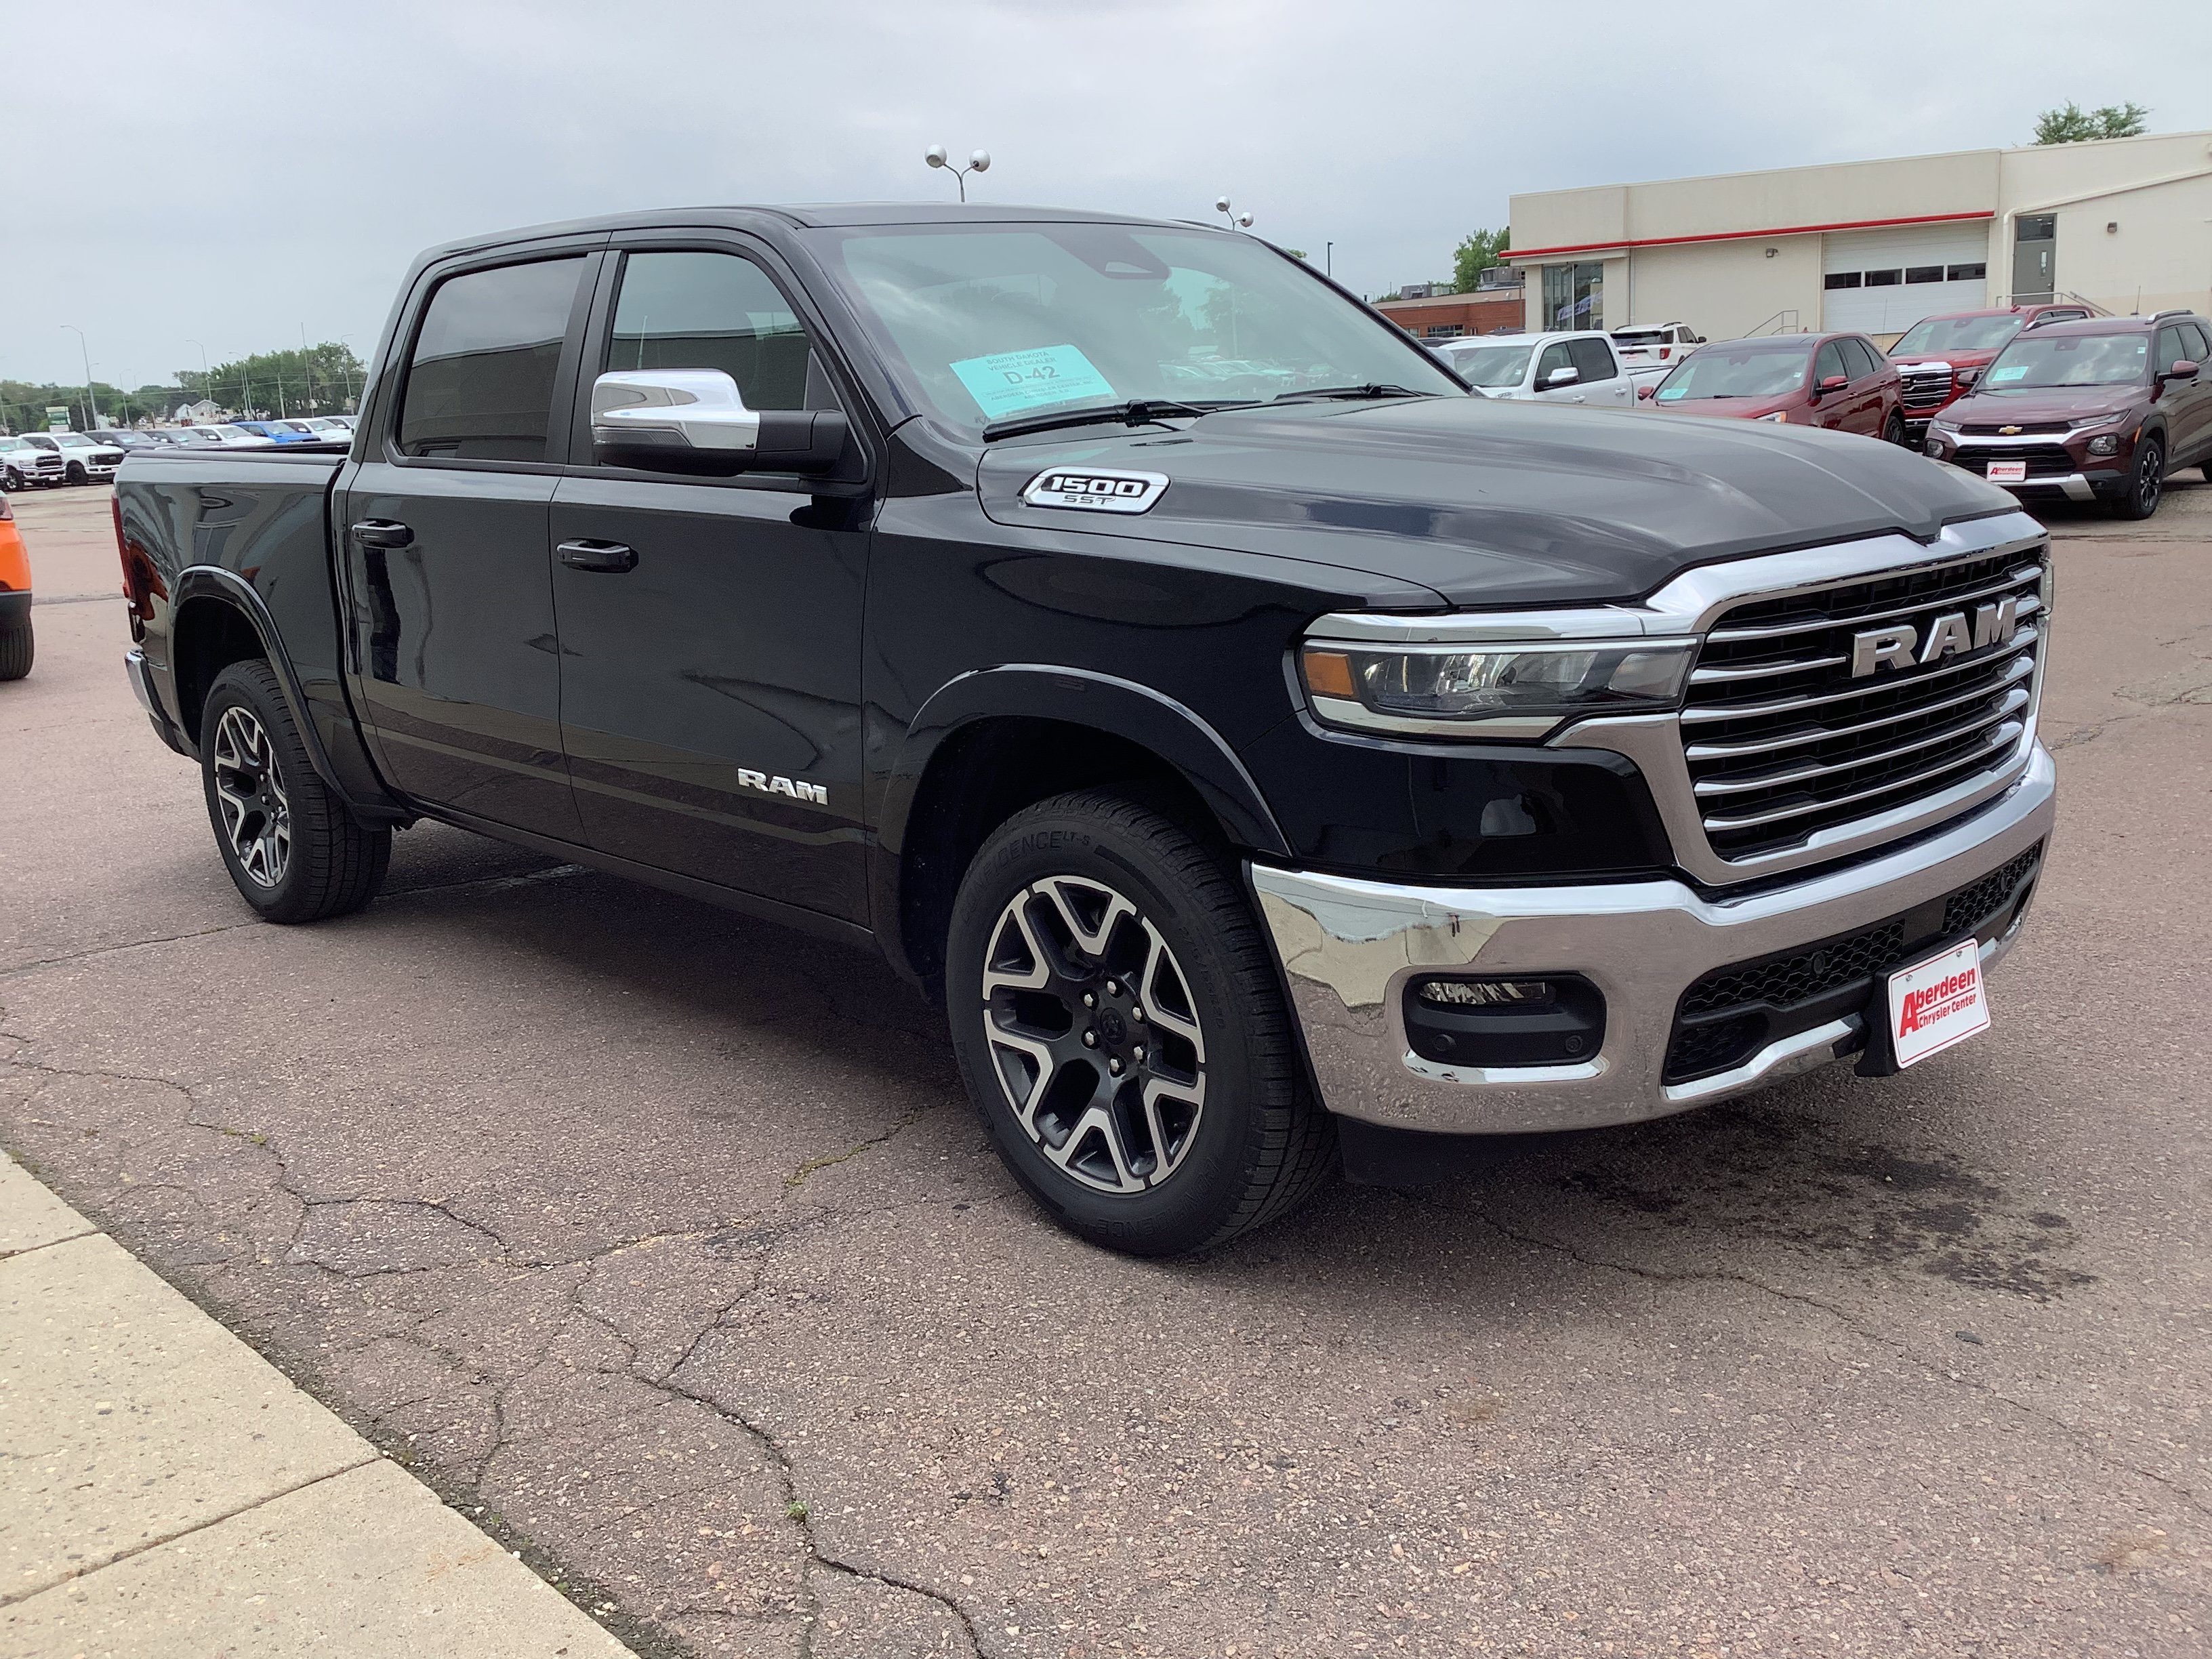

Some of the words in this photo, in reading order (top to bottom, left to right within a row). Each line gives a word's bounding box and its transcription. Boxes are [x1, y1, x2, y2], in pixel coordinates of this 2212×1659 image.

[986, 354, 1015, 365] SOUTH
[1016, 350, 1050, 361] DAKOTA
[988, 361, 1023, 371] VEHICLE
[1023, 356, 1057, 366] DEALER
[1003, 365, 1061, 385] D-42
[1051, 476, 1143, 497] 1500
[1062, 494, 1114, 505] SST
[1852, 596, 2017, 678] RAM
[737, 768, 828, 806] RAM
[1900, 968, 1976, 1038] Aberdeen
[1919, 1005, 1950, 1028] Chrysler
[1952, 993, 1977, 1012] Center
